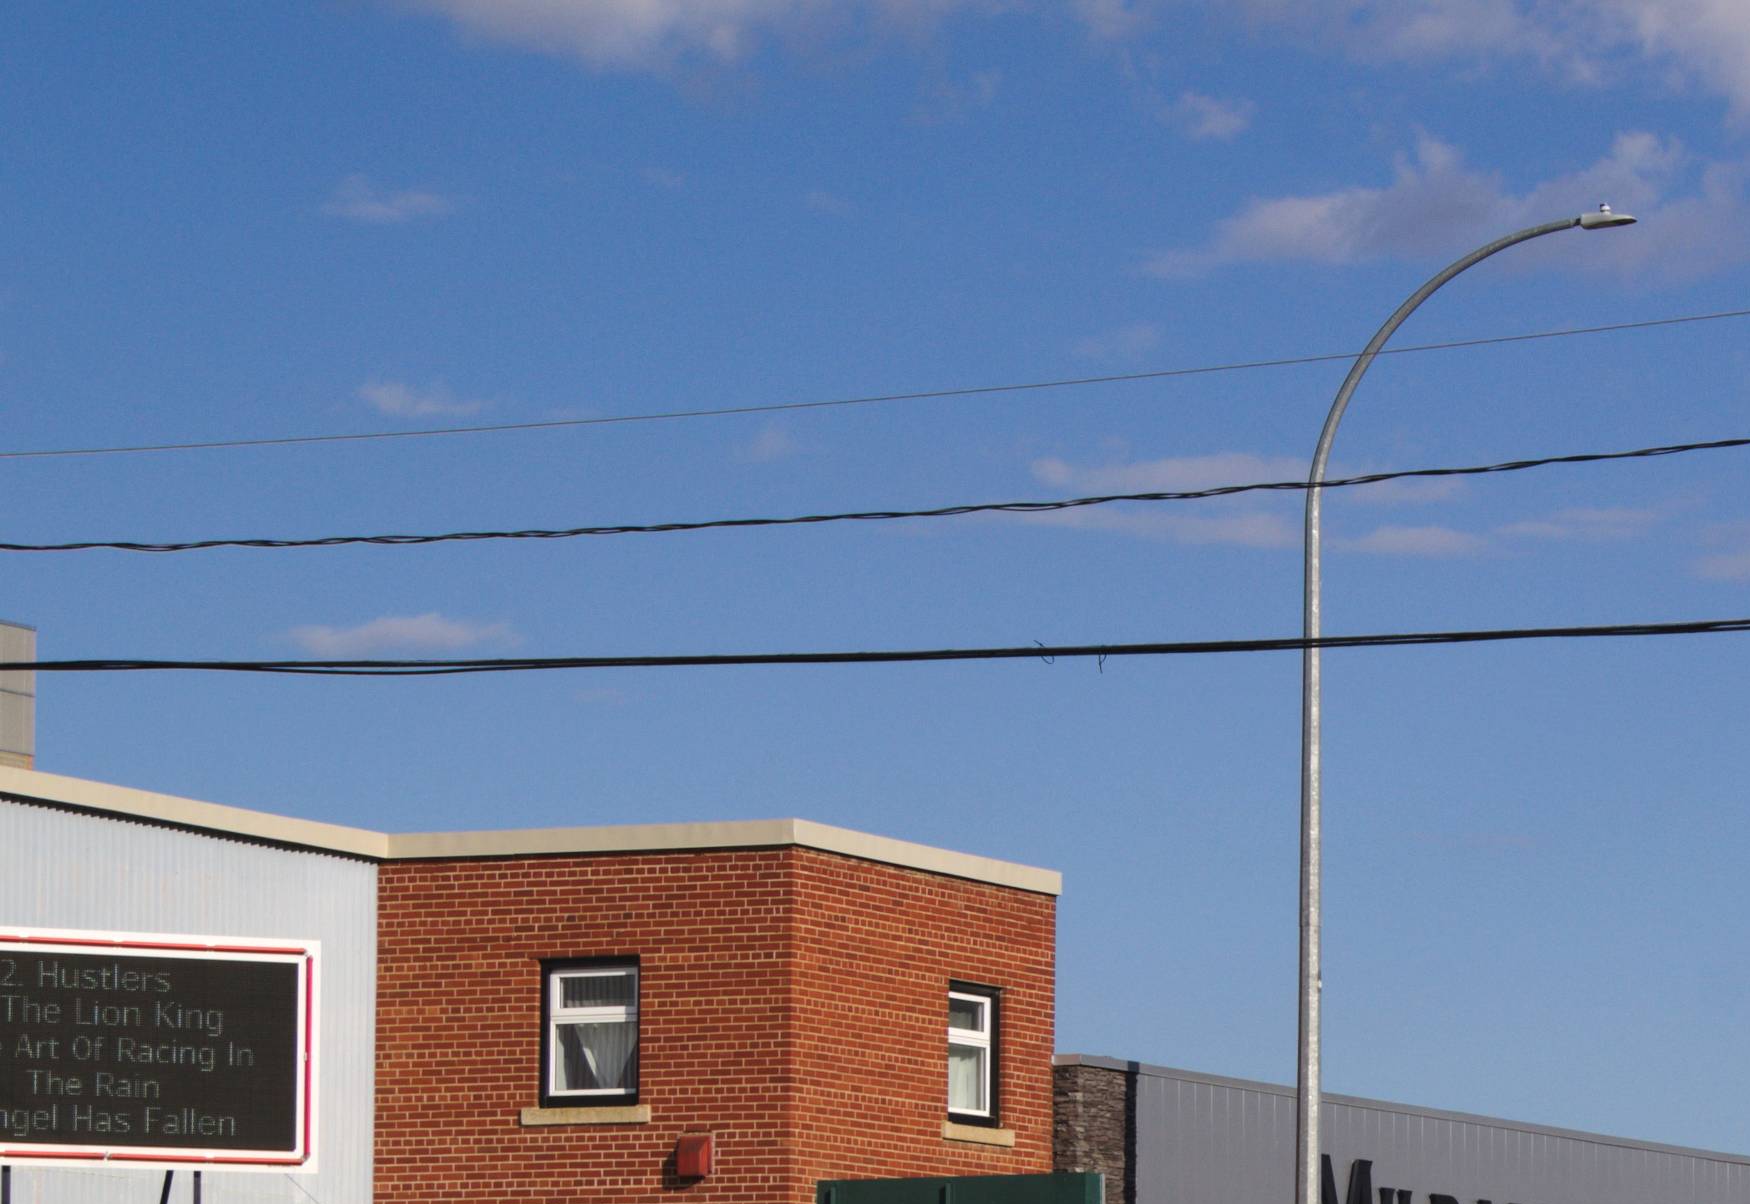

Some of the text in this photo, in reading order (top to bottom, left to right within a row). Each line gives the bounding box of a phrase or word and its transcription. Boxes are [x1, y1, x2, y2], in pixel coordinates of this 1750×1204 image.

[39, 960, 171, 993] Hustlers
[0, 995, 224, 1037] The Lion King
[15, 1033, 254, 1072] Art Of Racing In
[26, 1069, 160, 1098] The Rain
[72, 1104, 131, 1134] Has
[144, 1106, 236, 1137] Fallen
